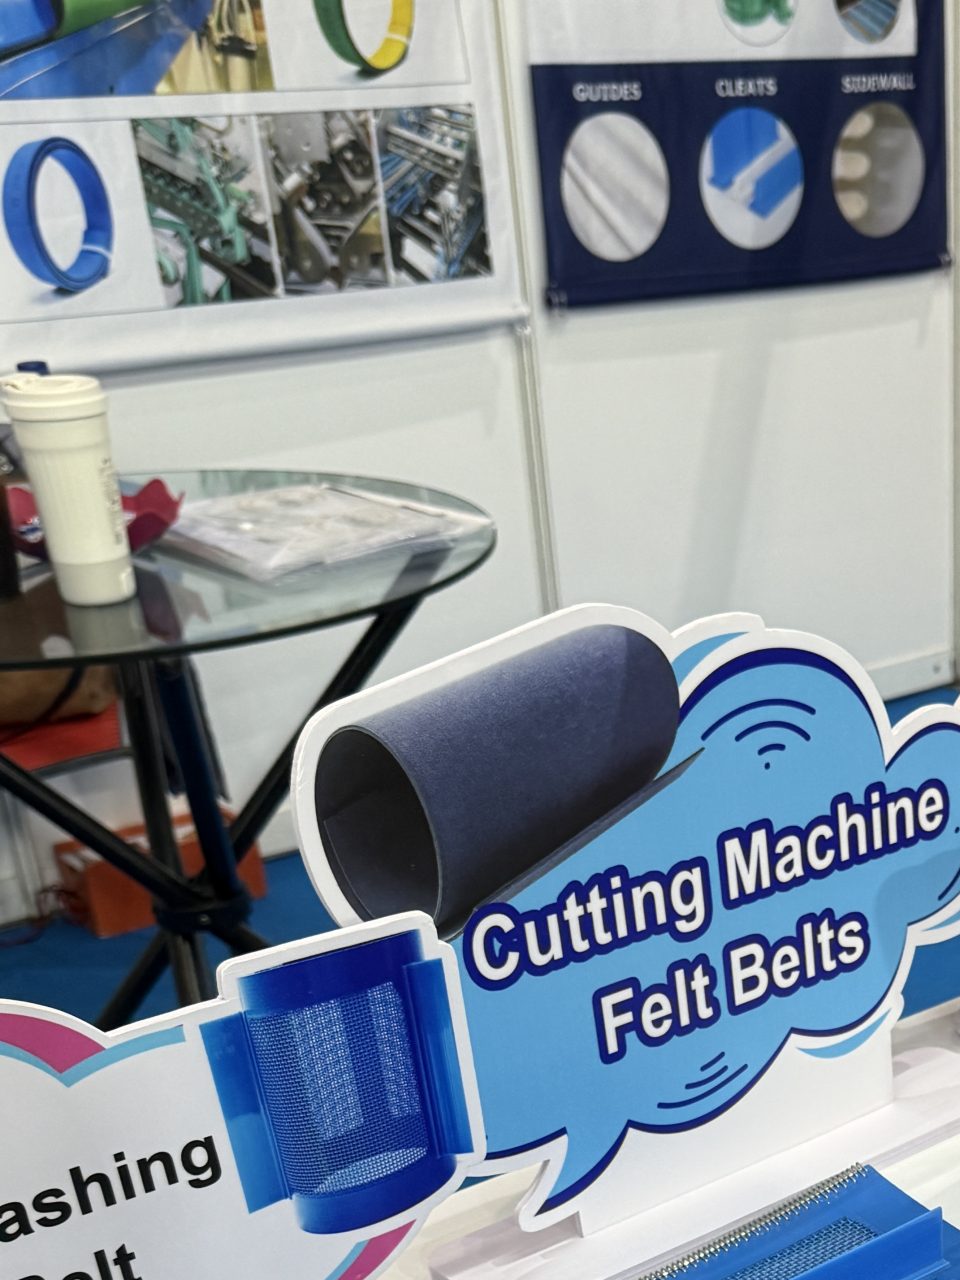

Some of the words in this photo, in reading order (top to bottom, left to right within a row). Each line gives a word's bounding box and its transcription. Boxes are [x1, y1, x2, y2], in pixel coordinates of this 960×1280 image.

[573, 81, 642, 102] GUIDES
[715, 77, 778, 97] CLEATS
[841, 73, 916, 93] SIDEWALL
[471, 864, 706, 981] Cutting
[723, 785, 945, 900] Machine
[599, 964, 714, 1056] Felt
[728, 916, 866, 1007] Belts
